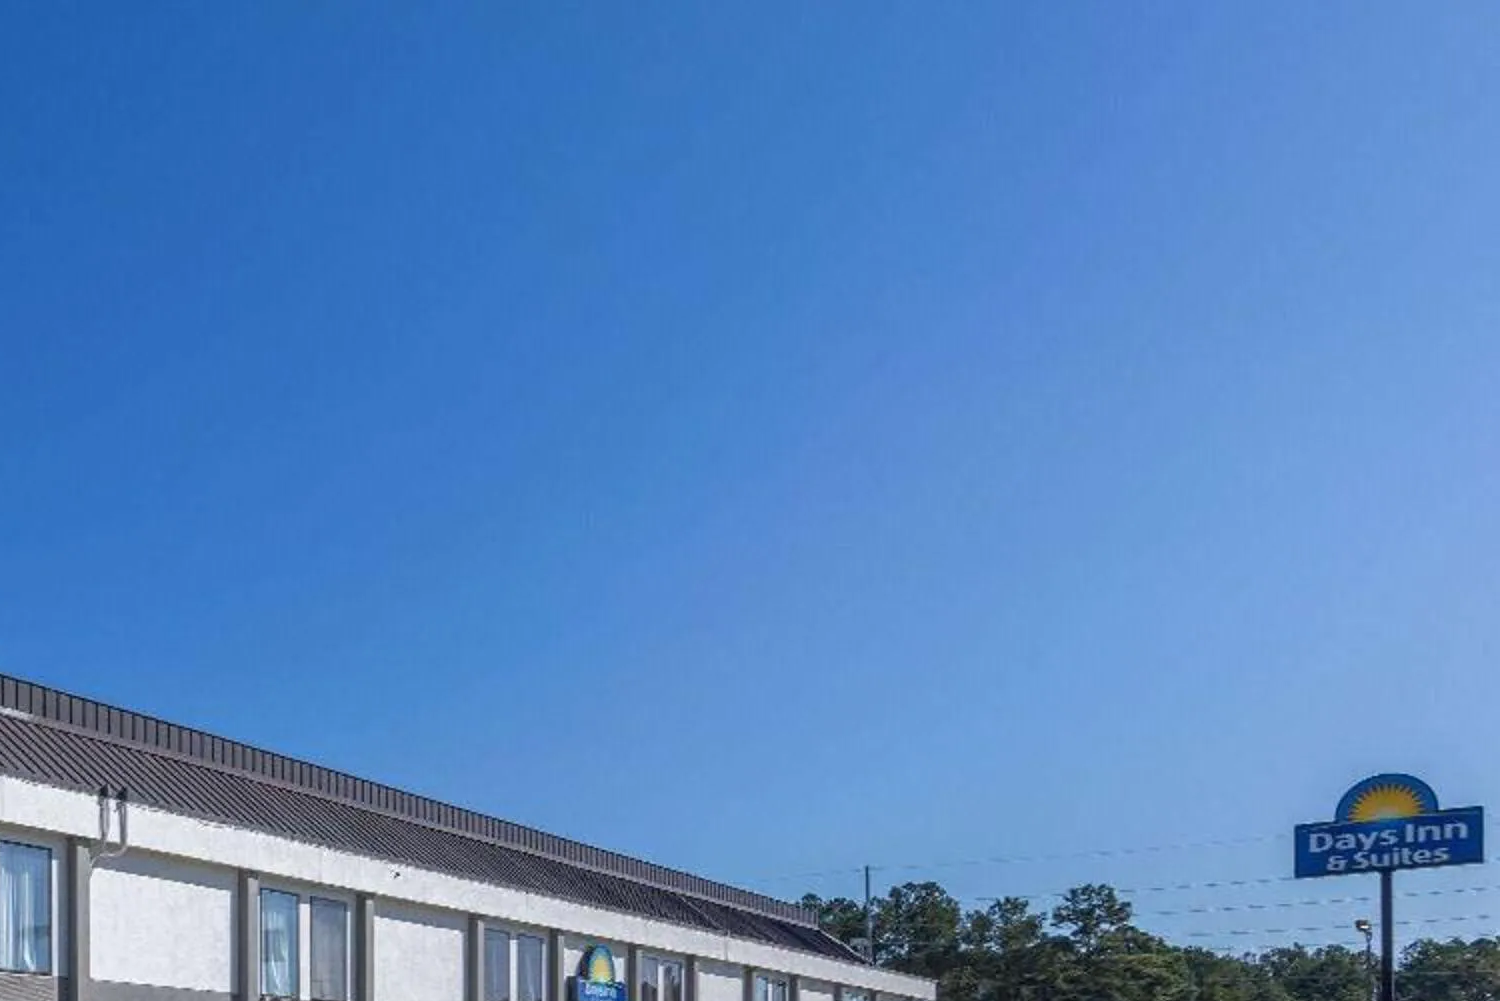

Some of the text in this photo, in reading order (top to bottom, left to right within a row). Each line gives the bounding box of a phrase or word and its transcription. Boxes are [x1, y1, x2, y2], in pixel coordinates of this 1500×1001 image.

[1308, 822, 1469, 853] Days Inn
[1326, 846, 1450, 871] & Suites
